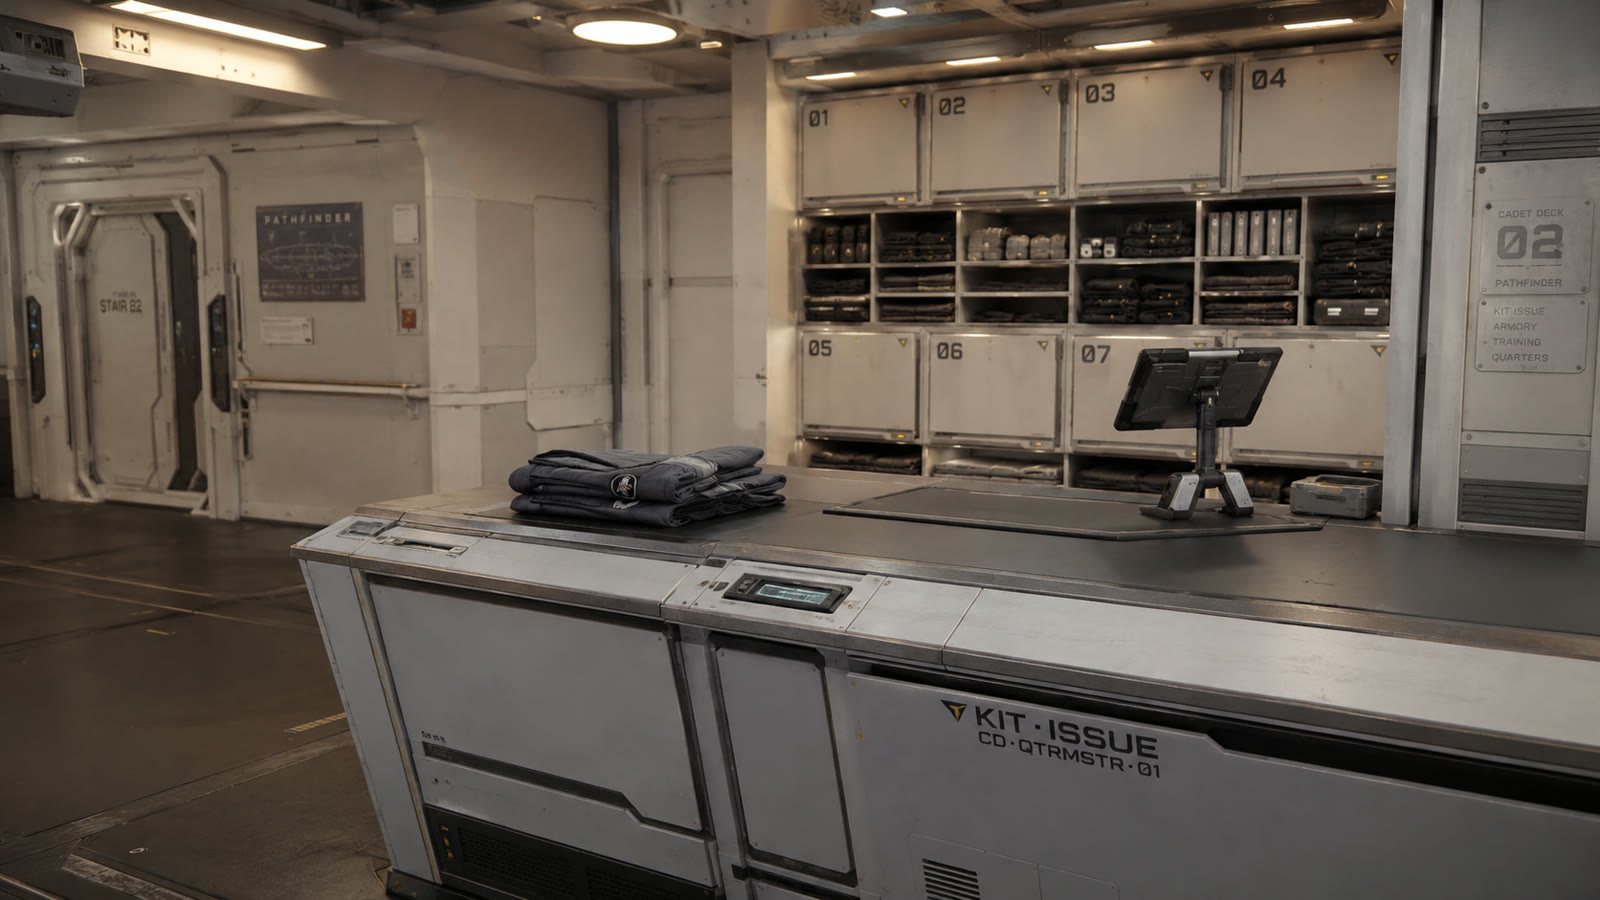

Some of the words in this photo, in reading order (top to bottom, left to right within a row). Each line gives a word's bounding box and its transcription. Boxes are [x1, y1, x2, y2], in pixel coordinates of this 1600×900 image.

[1252, 68, 1286, 90] 04
[1085, 83, 1115, 104] 03
[938, 97, 966, 116] 02
[808, 109, 829, 127] 01
[264, 212, 352, 225] PATHFINDER
[1498, 209, 1532, 218] CADET
[1536, 208, 1564, 218] DECK
[1497, 225, 1563, 258] 02
[1495, 278, 1562, 288] PATHFINDER
[100, 299, 128, 312] STAIR
[1493, 306, 1511, 316] KIT
[1514, 306, 1545, 316] ISSUE
[1492, 322, 1537, 331] ARMORY
[808, 339, 832, 357] 05
[936, 341, 963, 360] 06
[1492, 337, 1542, 347] TRAINING
[1081, 344, 1111, 364] 07
[1491, 353, 1549, 363] QUARTERS
[975, 706, 1026, 733] KIT
[1049, 719, 1159, 759] ISSUE
